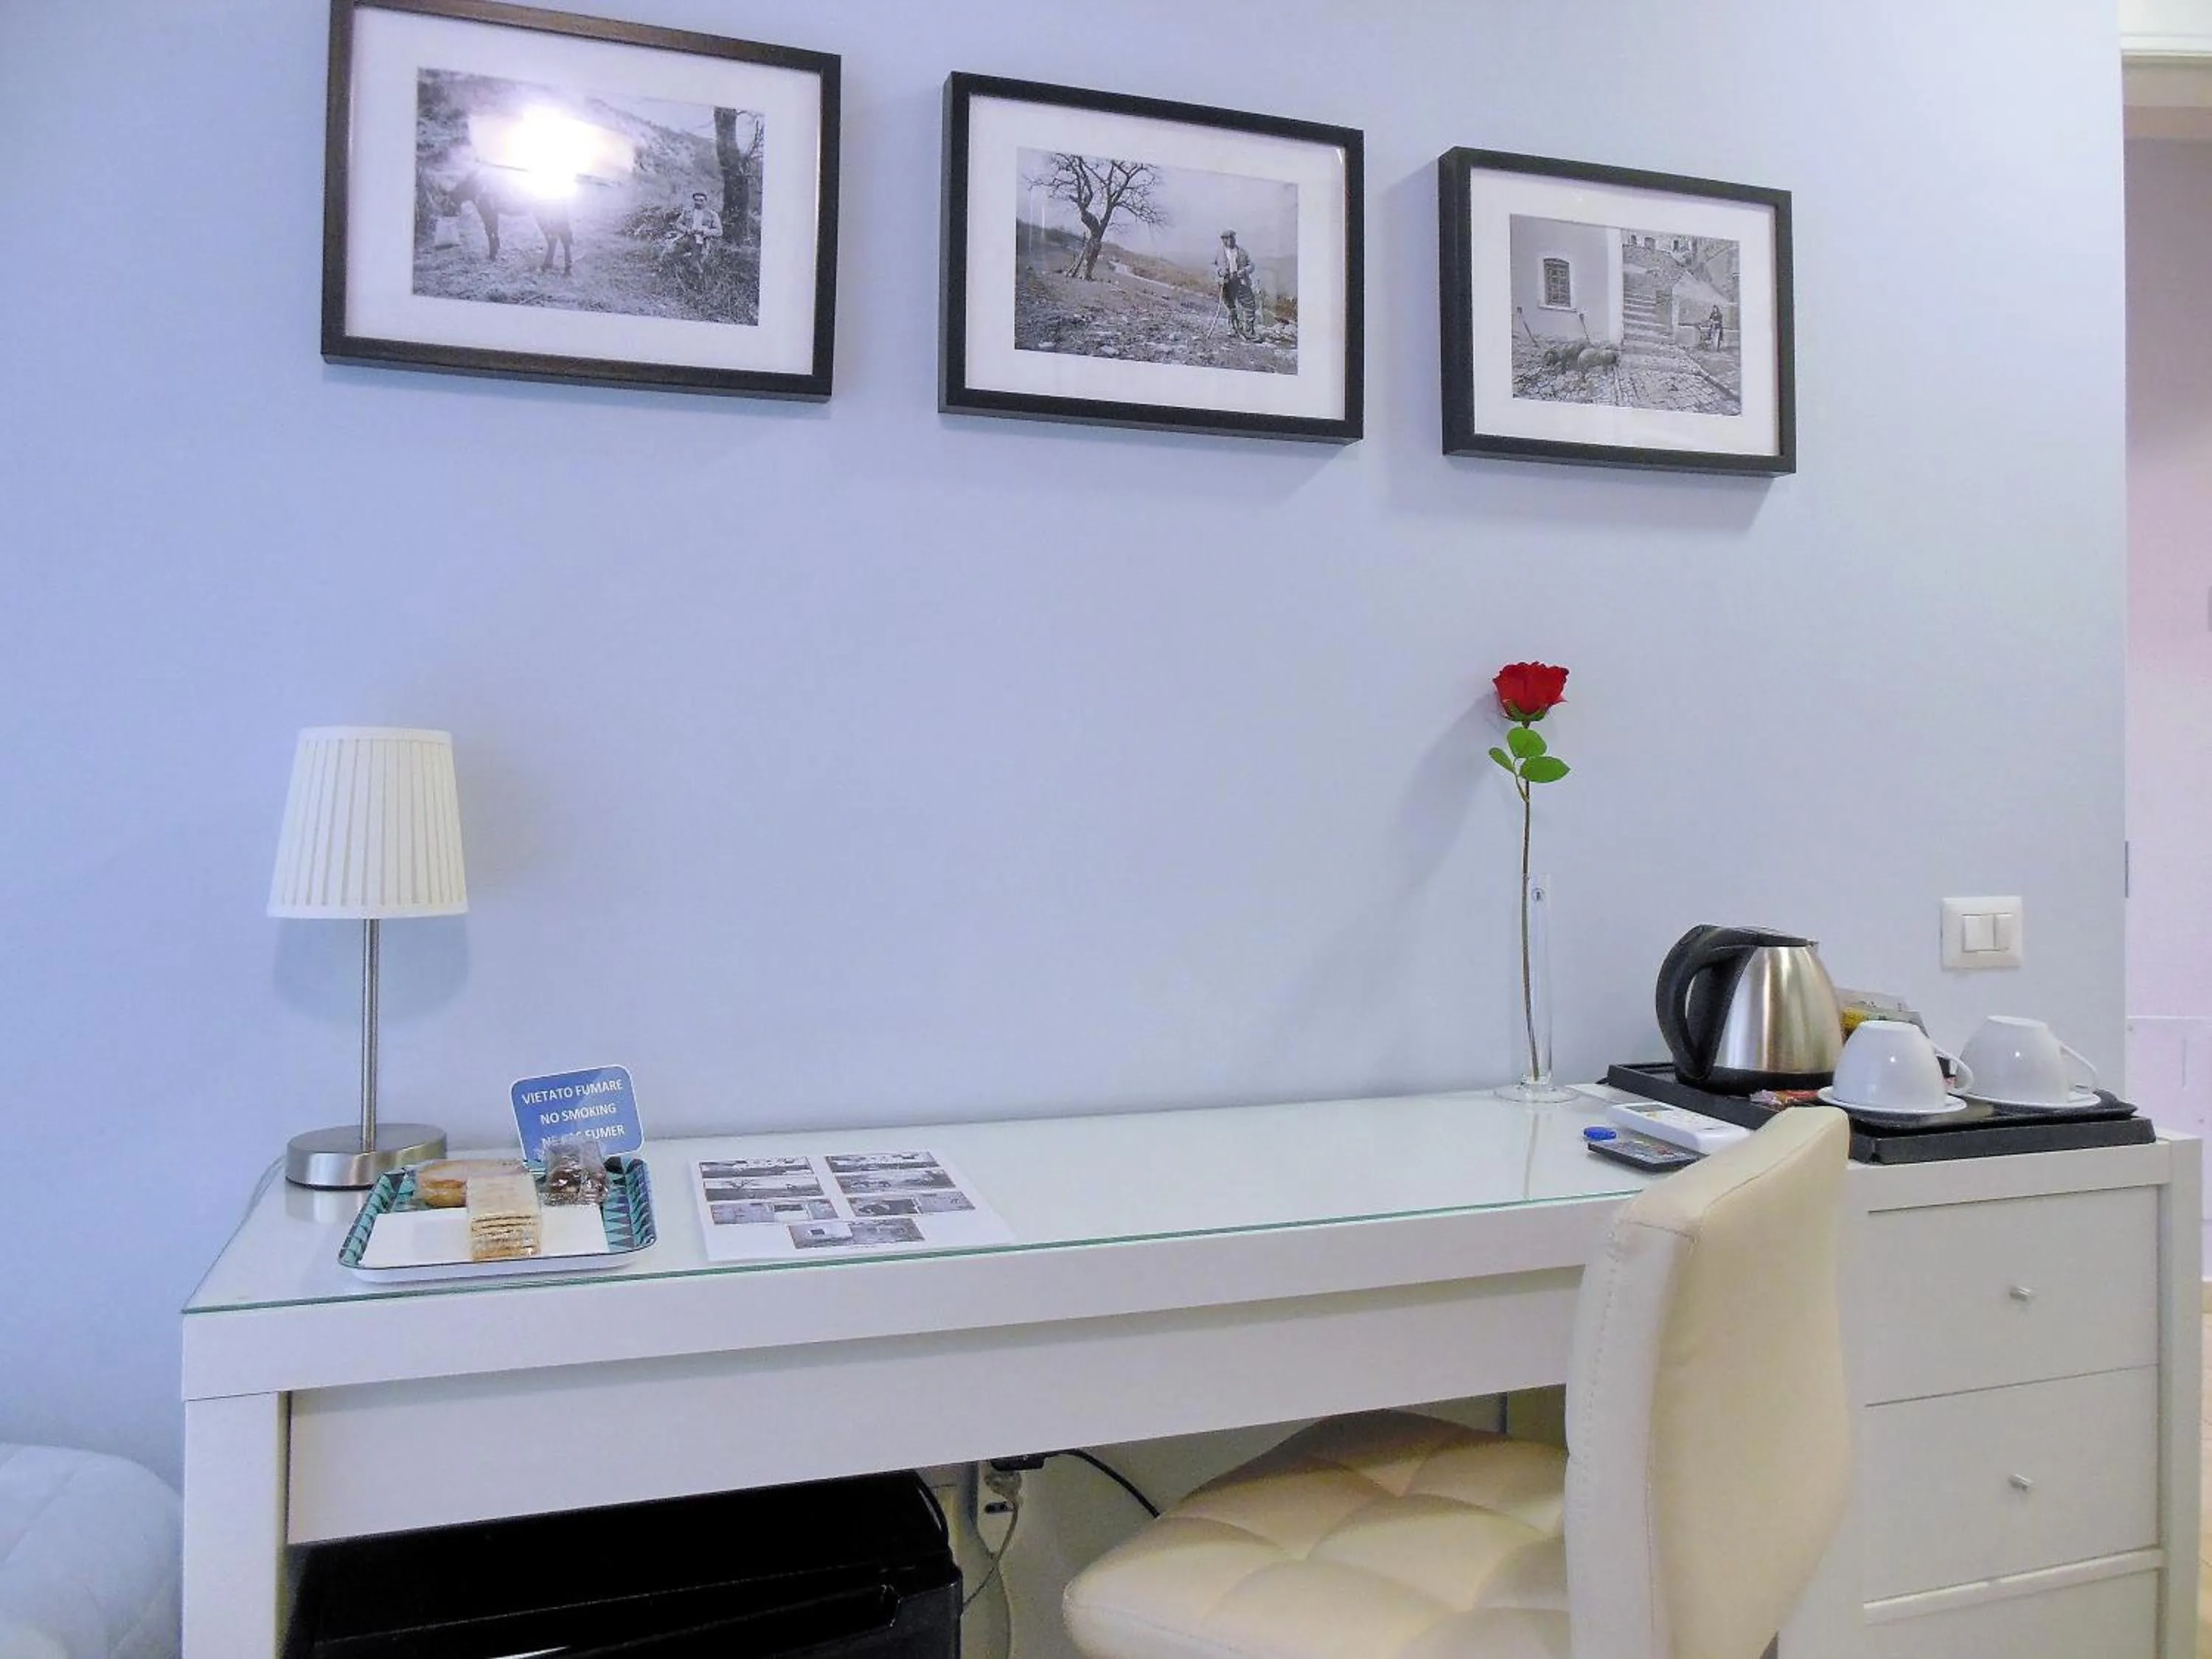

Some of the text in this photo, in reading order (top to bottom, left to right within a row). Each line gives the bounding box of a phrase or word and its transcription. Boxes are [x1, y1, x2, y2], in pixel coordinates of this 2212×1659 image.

[521, 1079, 624, 1105] VIETATO FUMARE
[540, 1102, 617, 1125] NO SMOKING
